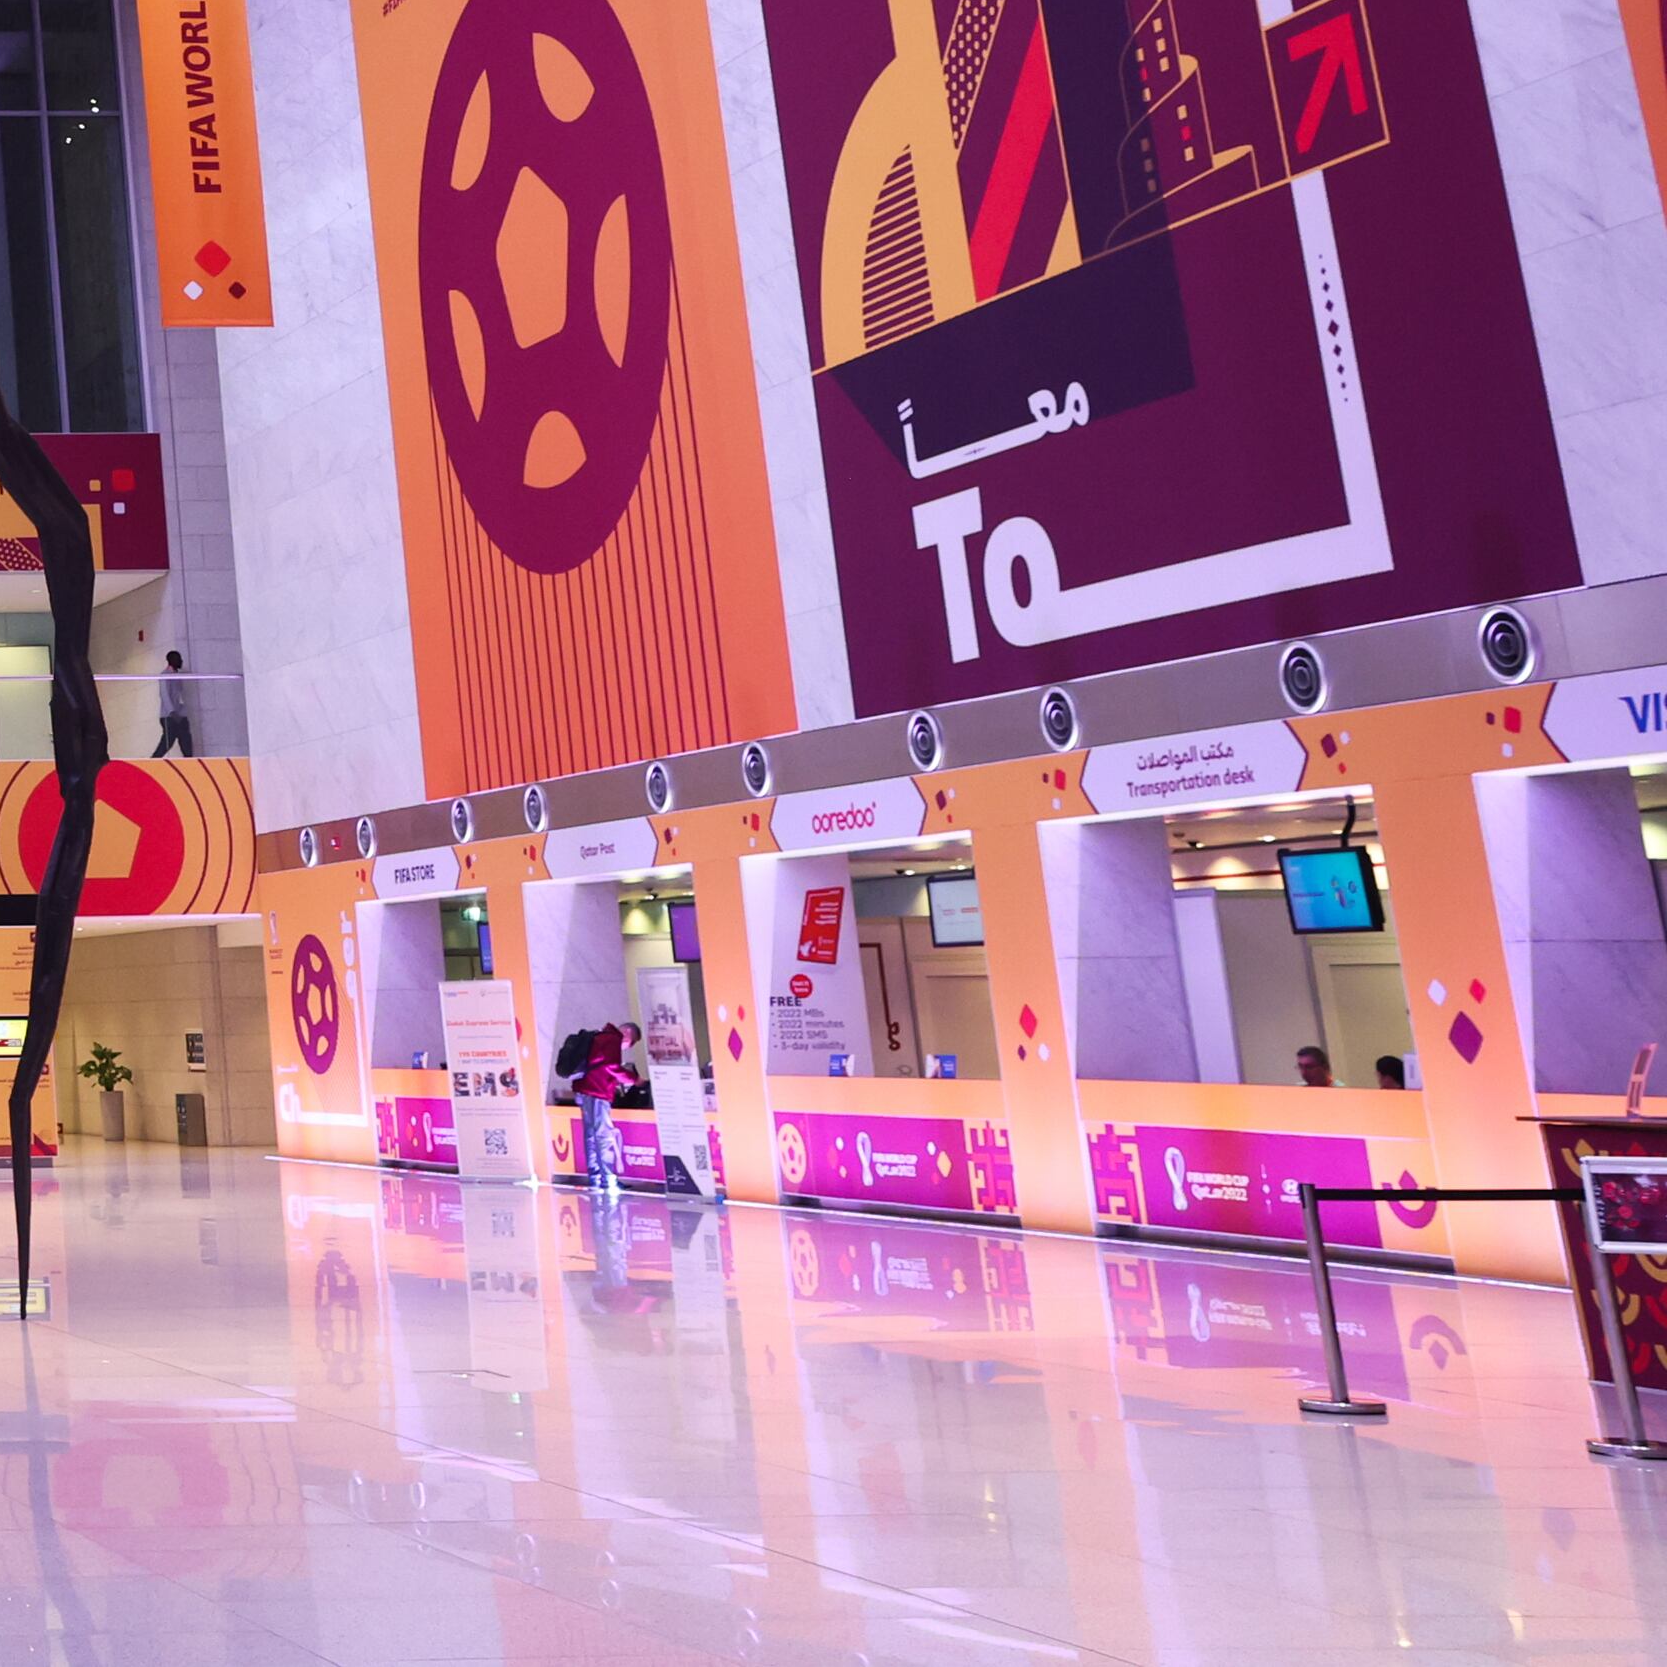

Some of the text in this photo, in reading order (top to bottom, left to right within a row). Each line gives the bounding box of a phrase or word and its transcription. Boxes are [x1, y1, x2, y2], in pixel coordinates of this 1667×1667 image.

[188, 112, 223, 194] FIFA
[1617, 692, 1667, 734] VI
[1136, 741, 1235, 771] مكتب المواصلات
[1126, 765, 1255, 798] Transportation desk
[811, 801, 875, 834] ooredoo
[599, 842, 616, 855] Post
[394, 863, 436, 884] FIFA STORE
[769, 995, 803, 1007] FREE
[452, 1068, 521, 1098] EMS
